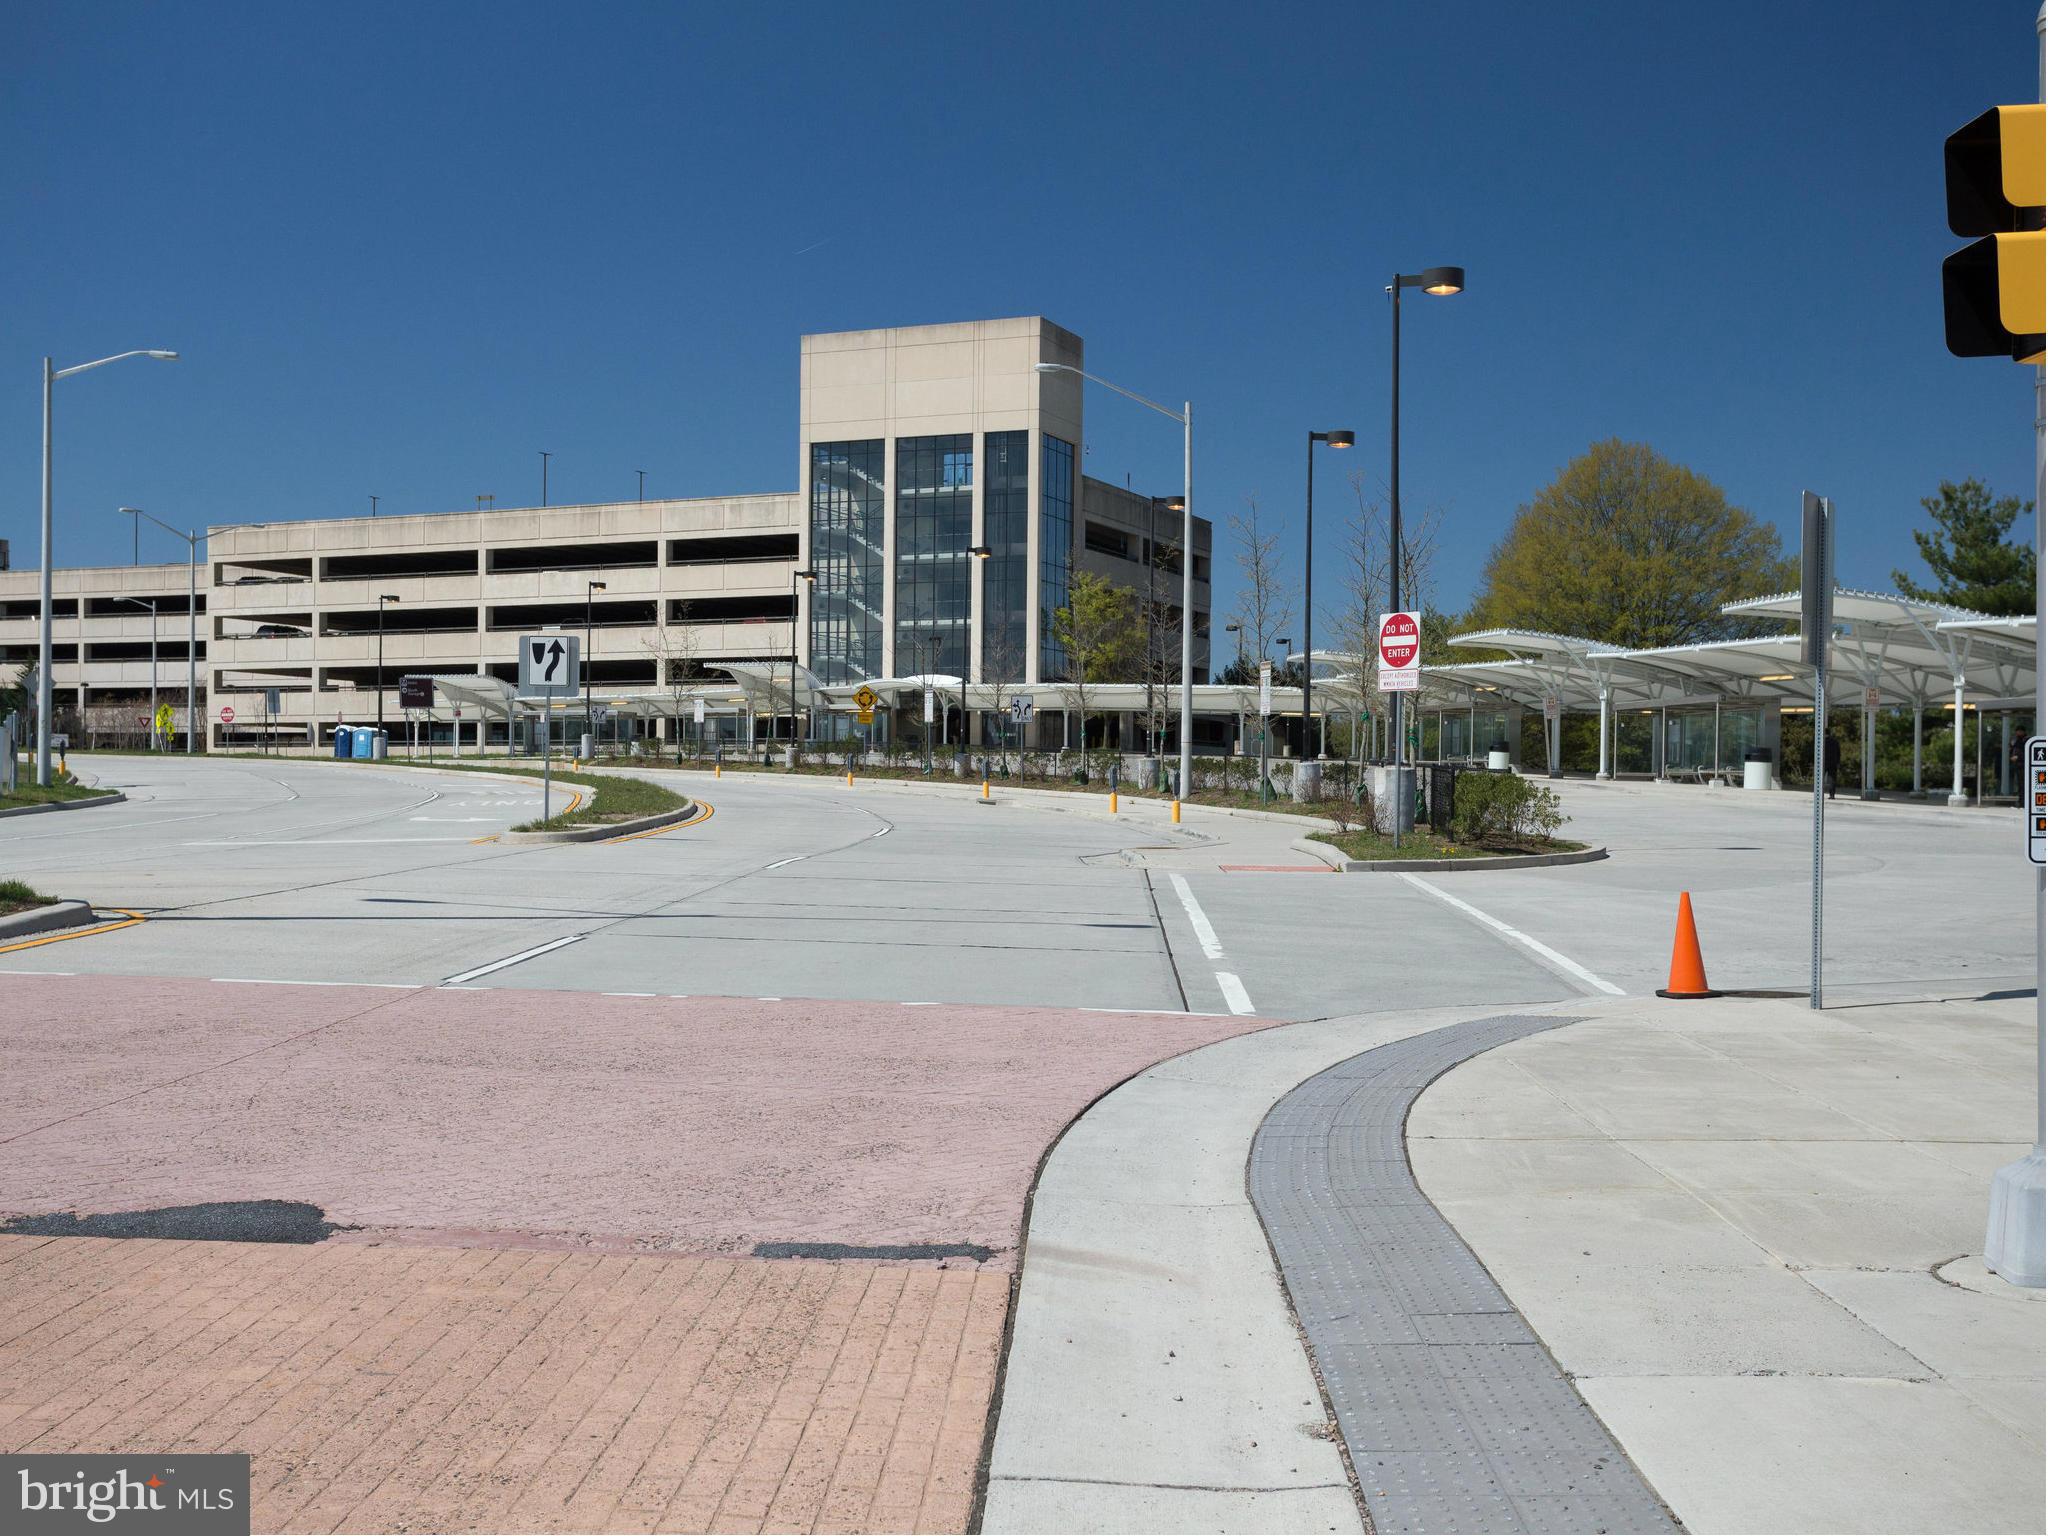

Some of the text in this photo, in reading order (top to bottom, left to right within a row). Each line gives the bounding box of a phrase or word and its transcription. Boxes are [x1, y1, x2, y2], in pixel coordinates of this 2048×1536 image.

[1385, 623, 1414, 634] DO NOT
[1387, 647, 1410, 658] ENTER
